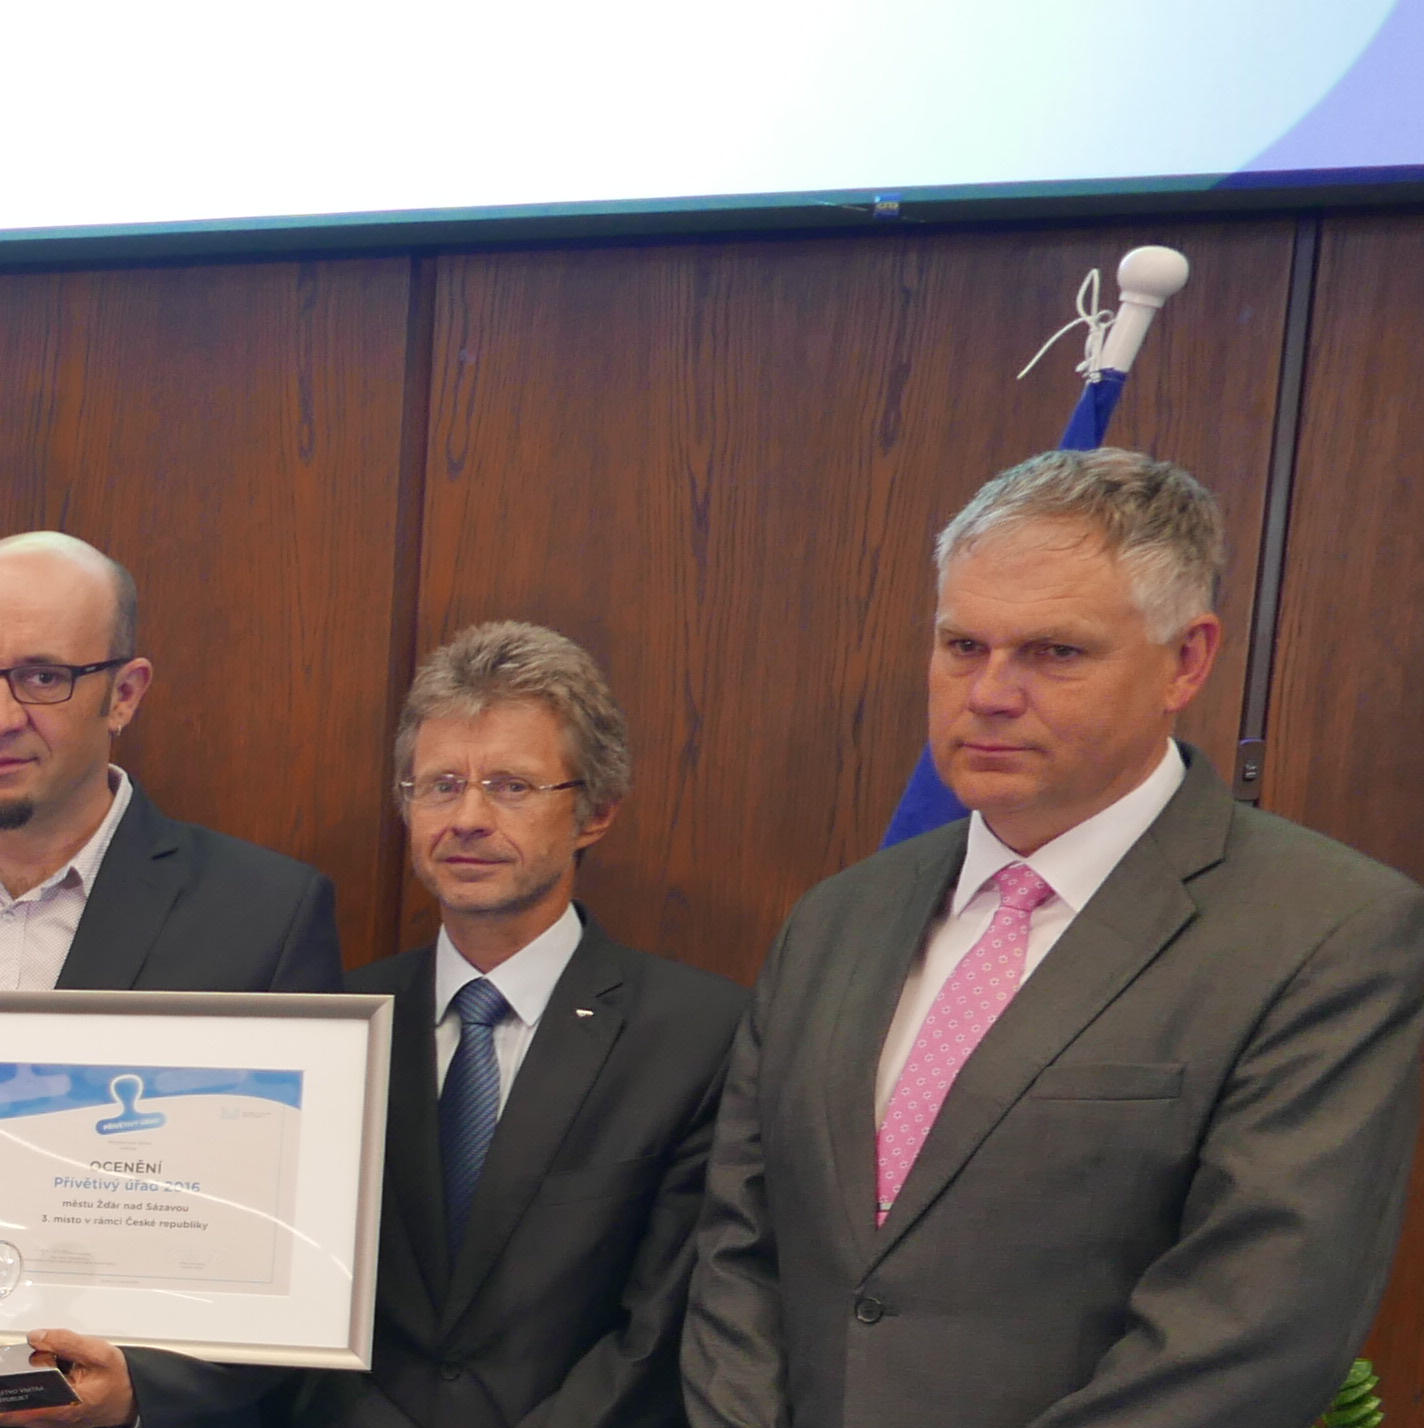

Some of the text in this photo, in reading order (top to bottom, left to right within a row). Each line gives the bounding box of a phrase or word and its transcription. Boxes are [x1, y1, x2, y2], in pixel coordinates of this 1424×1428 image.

[90, 1159, 163, 1174] OCENĚNÍ
[54, 1176, 120, 1192] Přívětivý
[164, 1181, 201, 1193] 2016
[123, 1201, 143, 1211] nad
